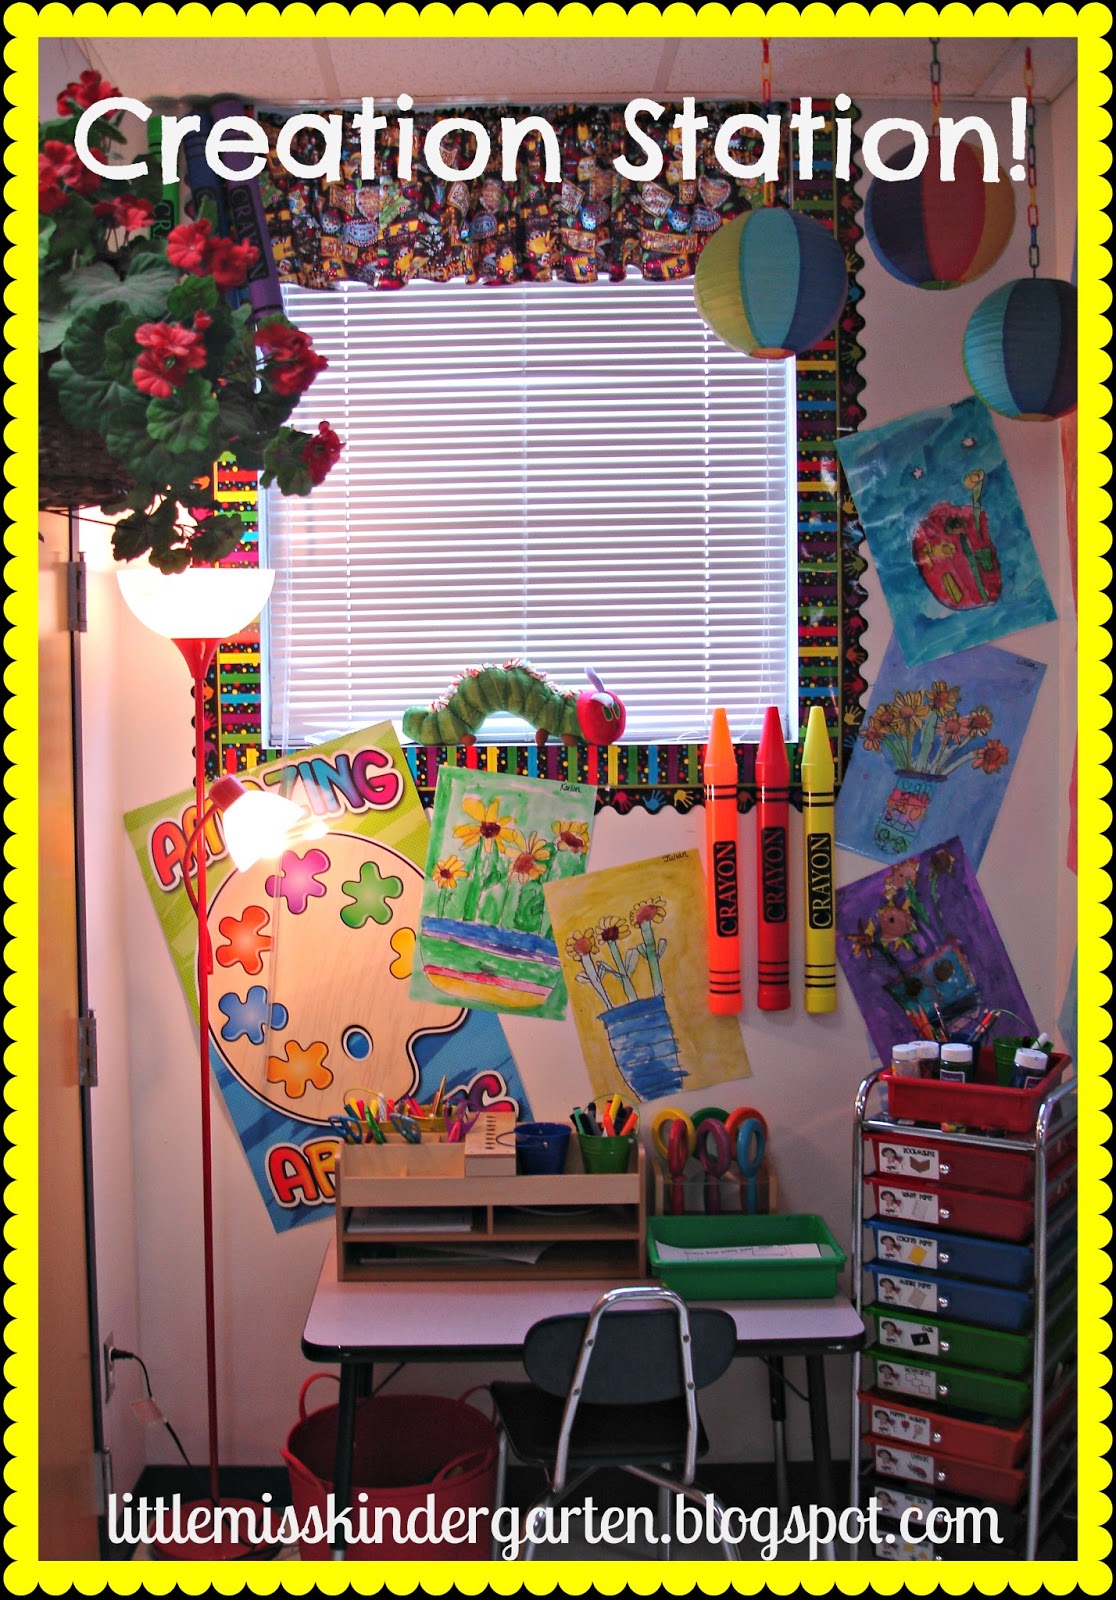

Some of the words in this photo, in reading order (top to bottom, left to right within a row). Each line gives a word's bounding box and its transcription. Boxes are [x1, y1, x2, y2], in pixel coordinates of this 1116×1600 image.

[714, 842, 738, 935] CRAYON
[764, 828, 786, 922] CRAYON
[809, 836, 833, 927] CRAYON
